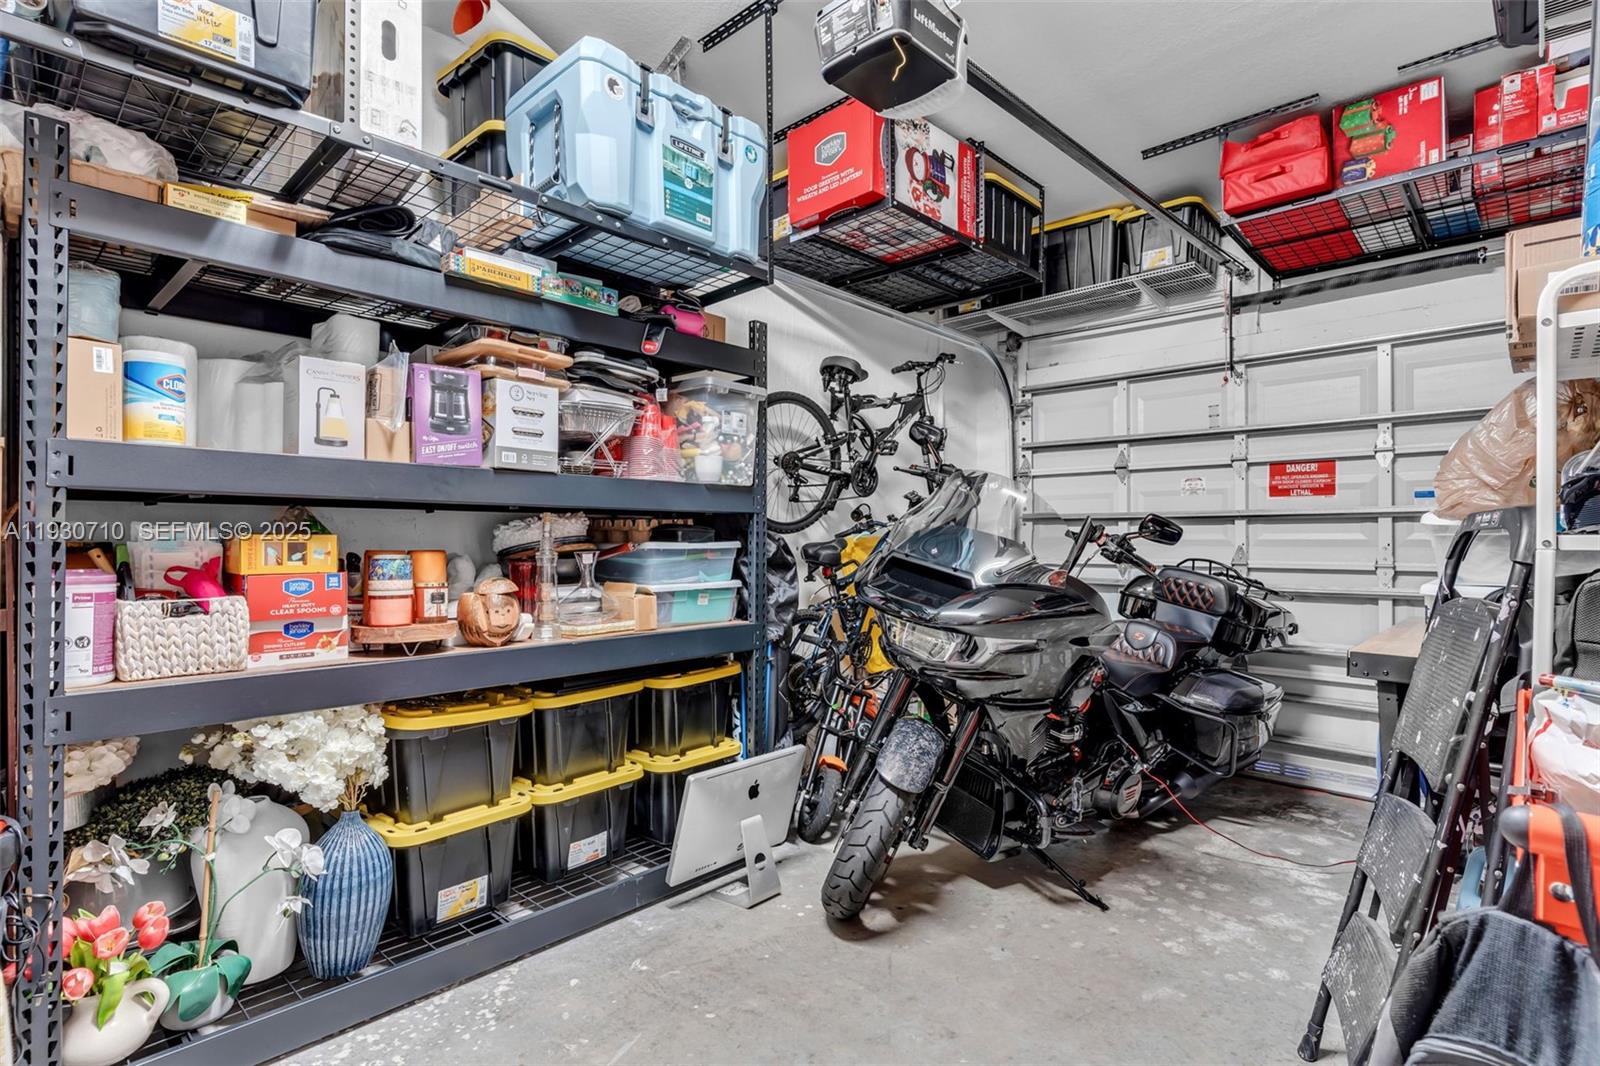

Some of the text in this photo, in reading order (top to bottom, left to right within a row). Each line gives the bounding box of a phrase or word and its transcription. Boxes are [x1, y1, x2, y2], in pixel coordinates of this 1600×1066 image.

[913, 8, 954, 47] LiftMaster
[796, 189, 818, 203] WREATH
[819, 184, 830, 194] AND
[830, 180, 840, 190] LED
[840, 169, 864, 184] LANTERN
[803, 183, 818, 195] DOOR
[818, 174, 840, 188] GREETER
[840, 167, 855, 178] WITH
[421, 445, 436, 455] EASY
[437, 443, 457, 453] ON/OFF
[1286, 463, 1318, 473] DANGER!
[270, 608, 295, 616] CLEAR
